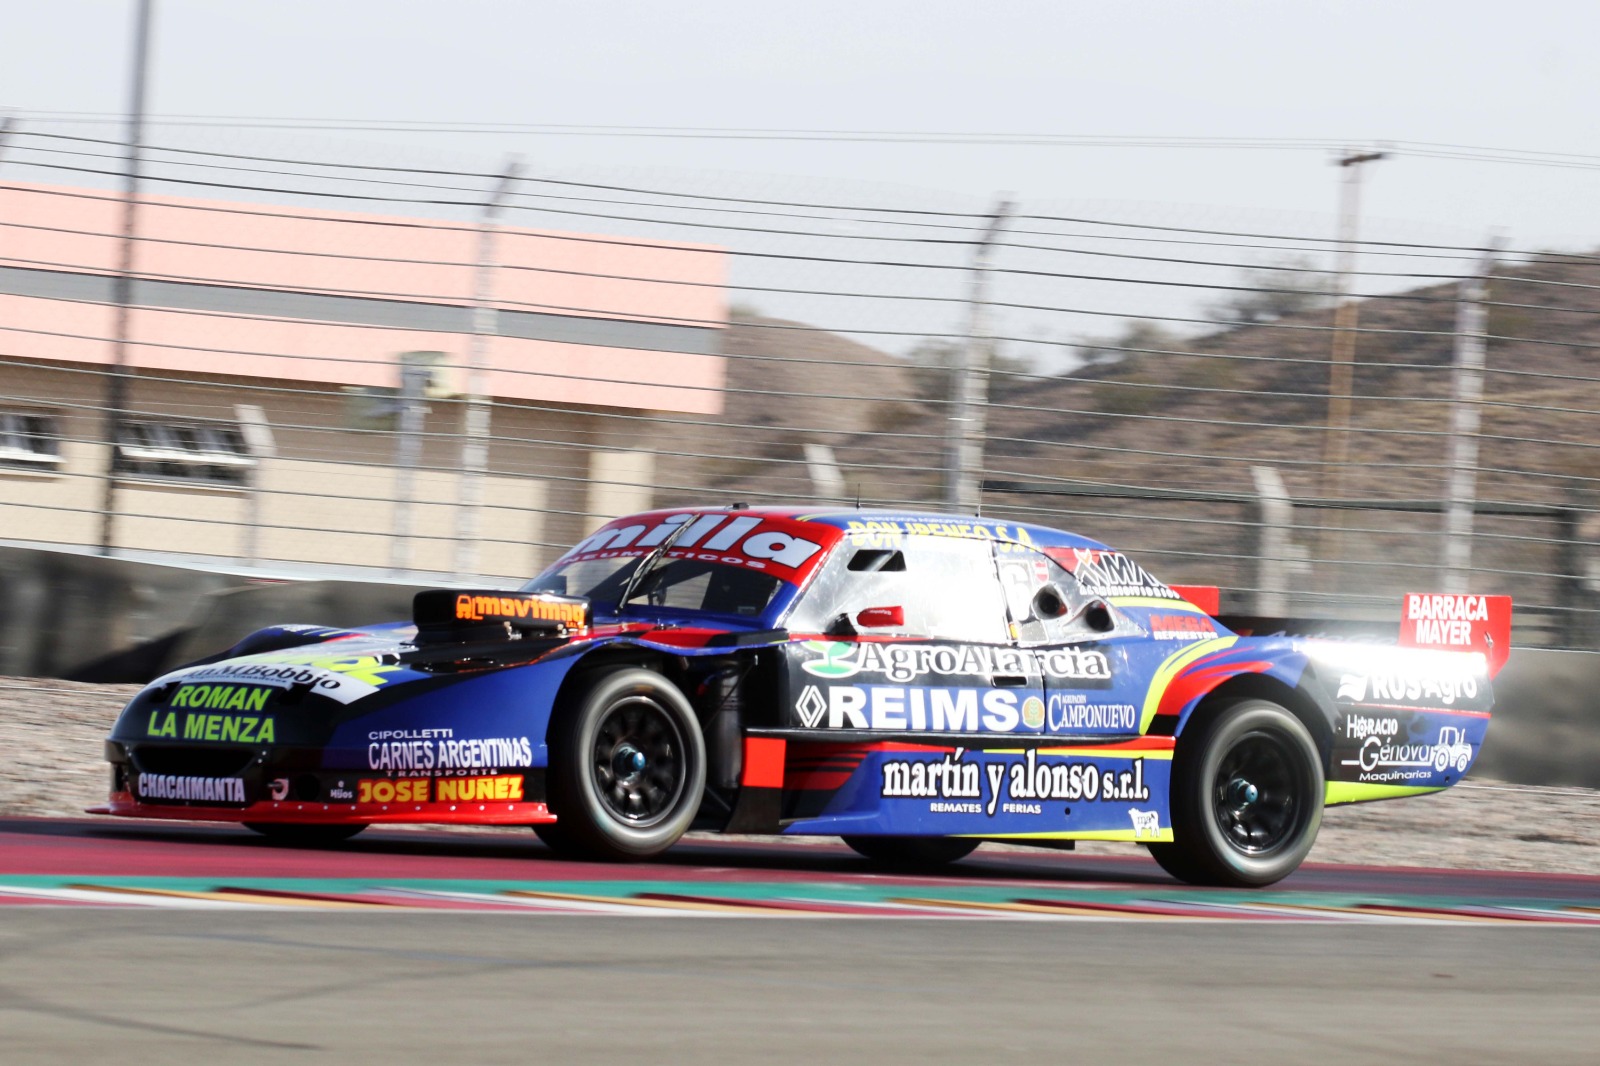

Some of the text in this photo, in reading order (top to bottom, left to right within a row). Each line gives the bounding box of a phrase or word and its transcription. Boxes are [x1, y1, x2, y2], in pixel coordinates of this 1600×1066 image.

[847, 521, 903, 547] DON
[560, 550, 766, 569] NEUMTICOS
[1408, 595, 1488, 621] BARRACA
[1150, 614, 1215, 632] MEGA
[1416, 620, 1472, 645] MAYER
[859, 641, 1112, 682] AgroAlarcia
[171, 684, 272, 711] ROMAN
[828, 686, 1020, 731] REIMS
[1048, 693, 1136, 732] CAMPONUEVO
[147, 711, 275, 743] LA MENZA
[368, 728, 454, 740] CIPOLLETTI
[368, 736, 533, 770] CARNES ARGENTINAS
[1359, 736, 1431, 771] Génova
[386, 768, 498, 777] TRANSPORTE
[882, 747, 1149, 815] martín y alonso s.r.l.
[1359, 770, 1432, 782] Maquinarias
[138, 772, 246, 802] CHACAIMANTA
[330, 789, 354, 799] Hijos
[359, 775, 525, 803] JOSE NUÑEZ
[930, 802, 1042, 814] REMATES FERIAS
